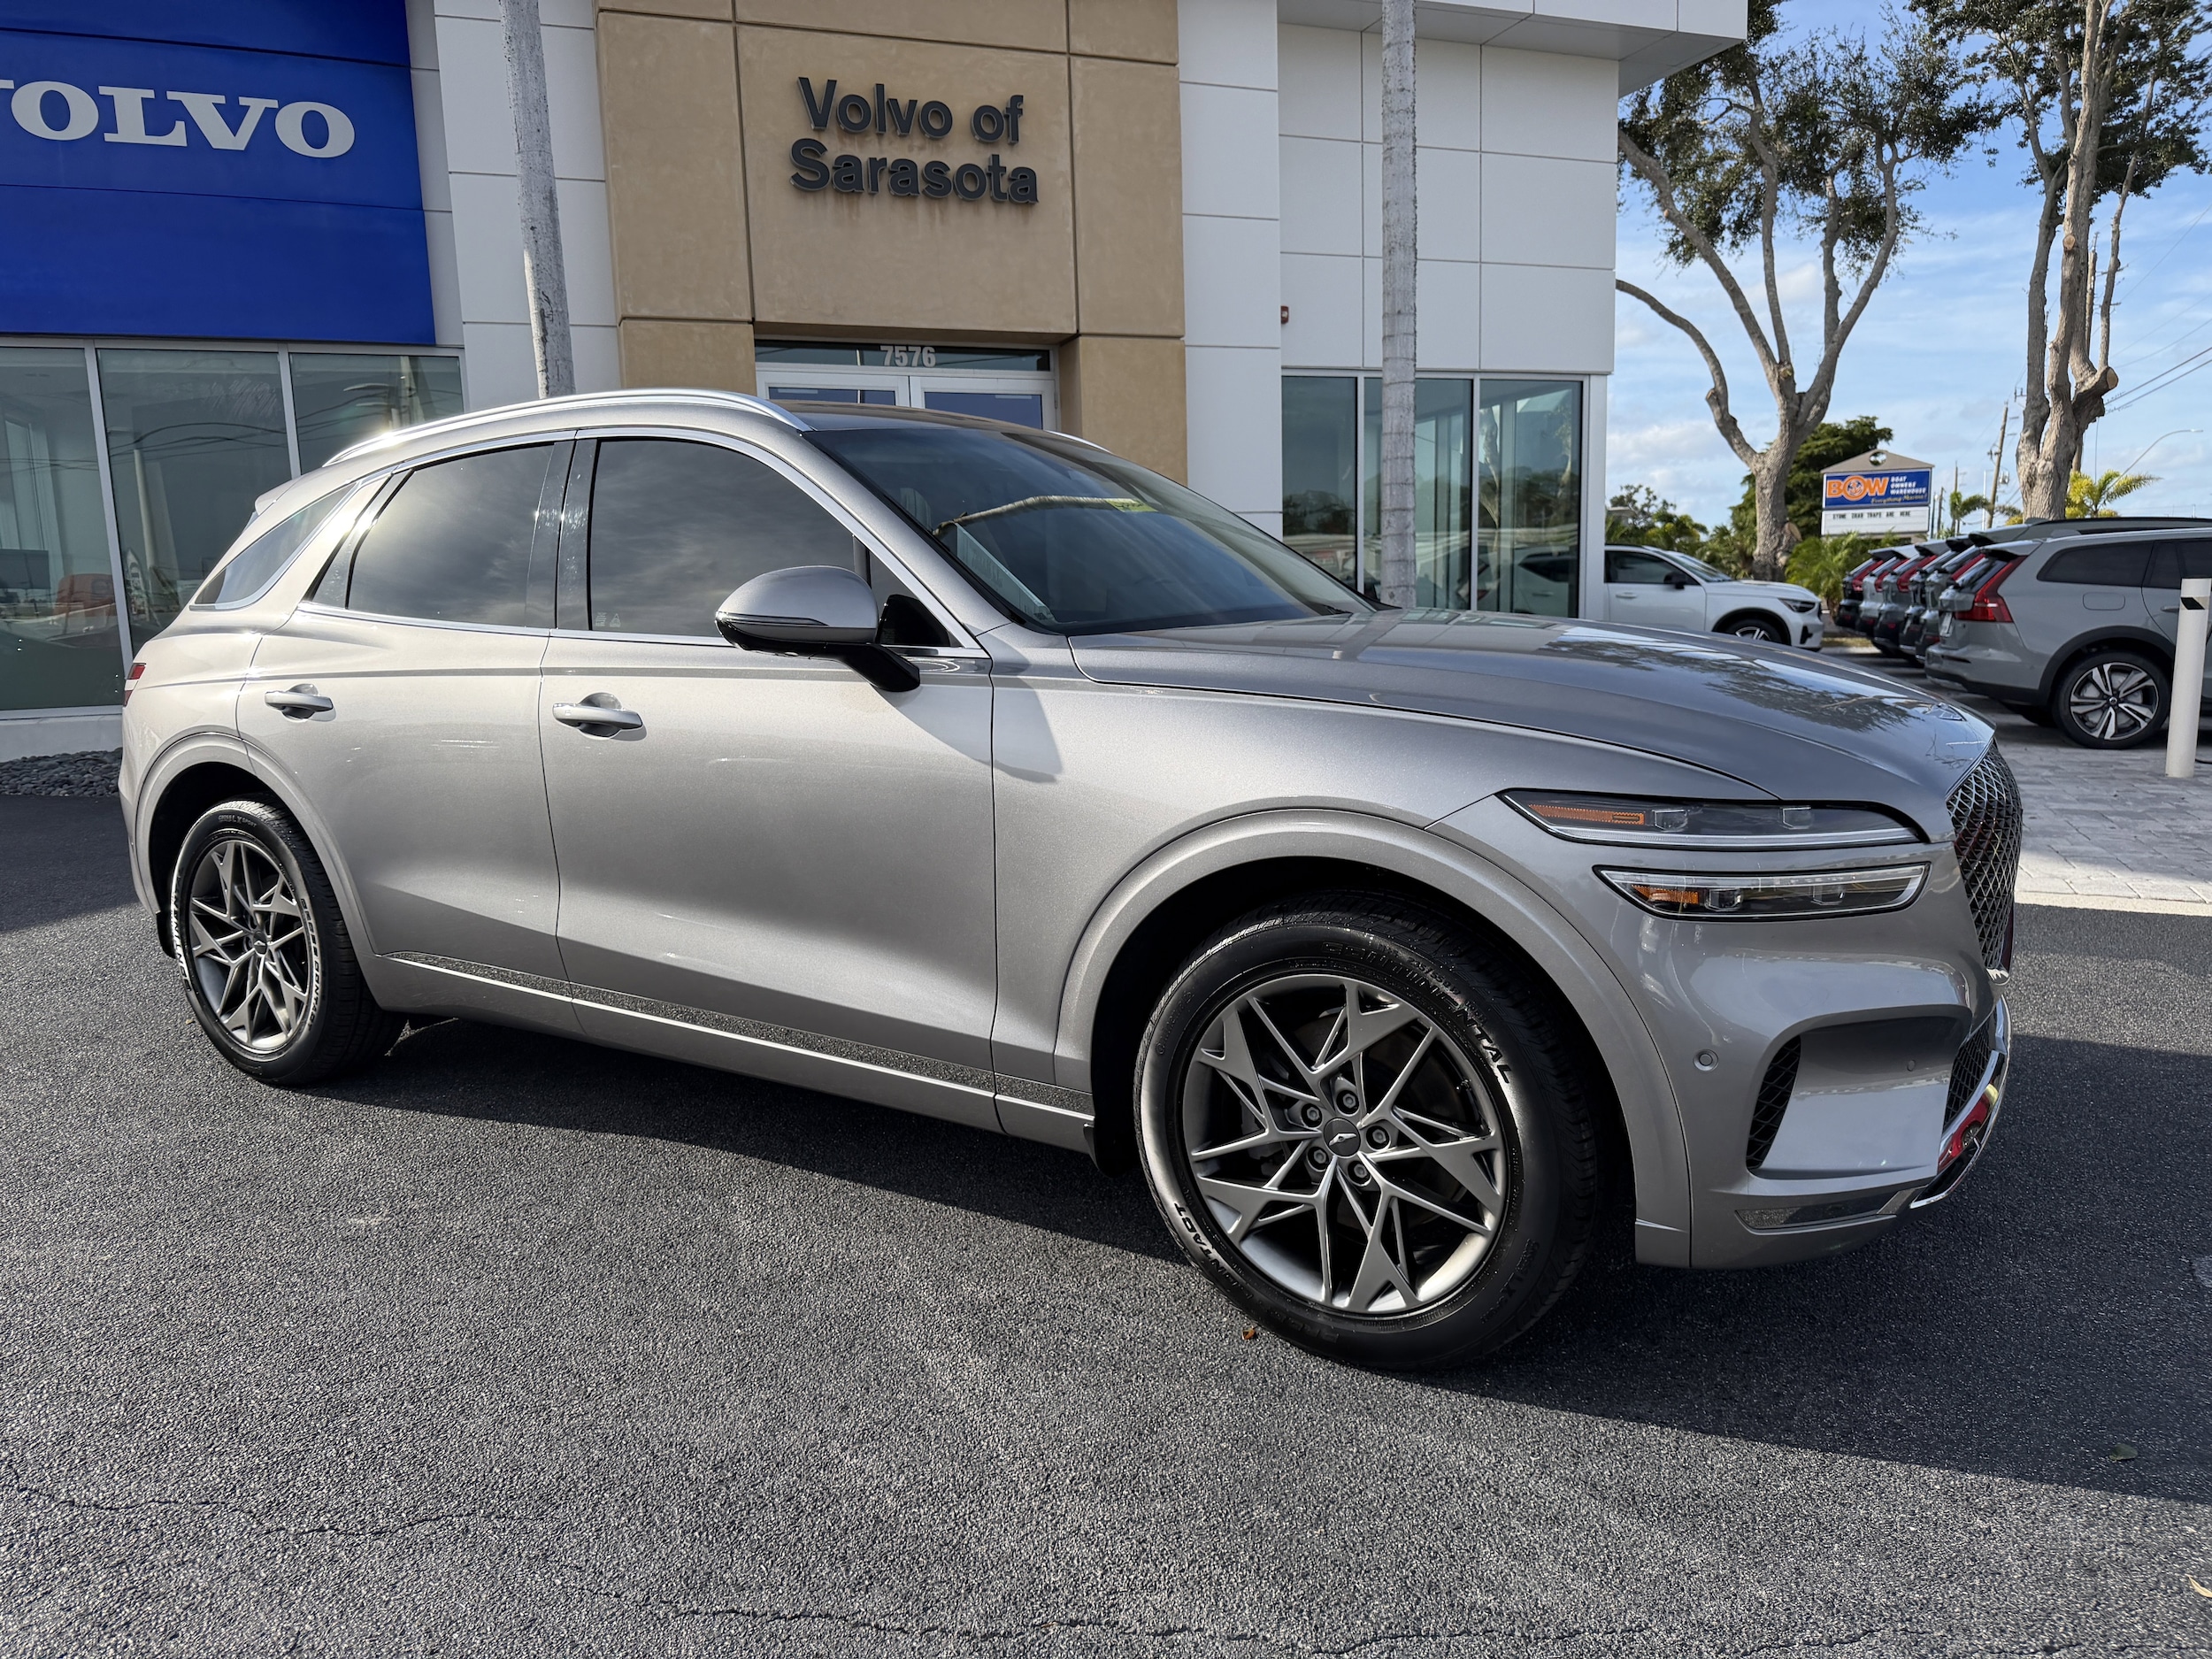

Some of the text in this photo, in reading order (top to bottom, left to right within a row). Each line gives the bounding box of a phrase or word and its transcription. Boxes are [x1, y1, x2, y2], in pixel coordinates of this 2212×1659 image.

[0, 80, 356, 158] OLVO
[797, 76, 1024, 144] Volvo of
[789, 137, 1039, 204] Sarasota
[880, 345, 936, 368] 7576
[1826, 475, 1889, 502] BOW
